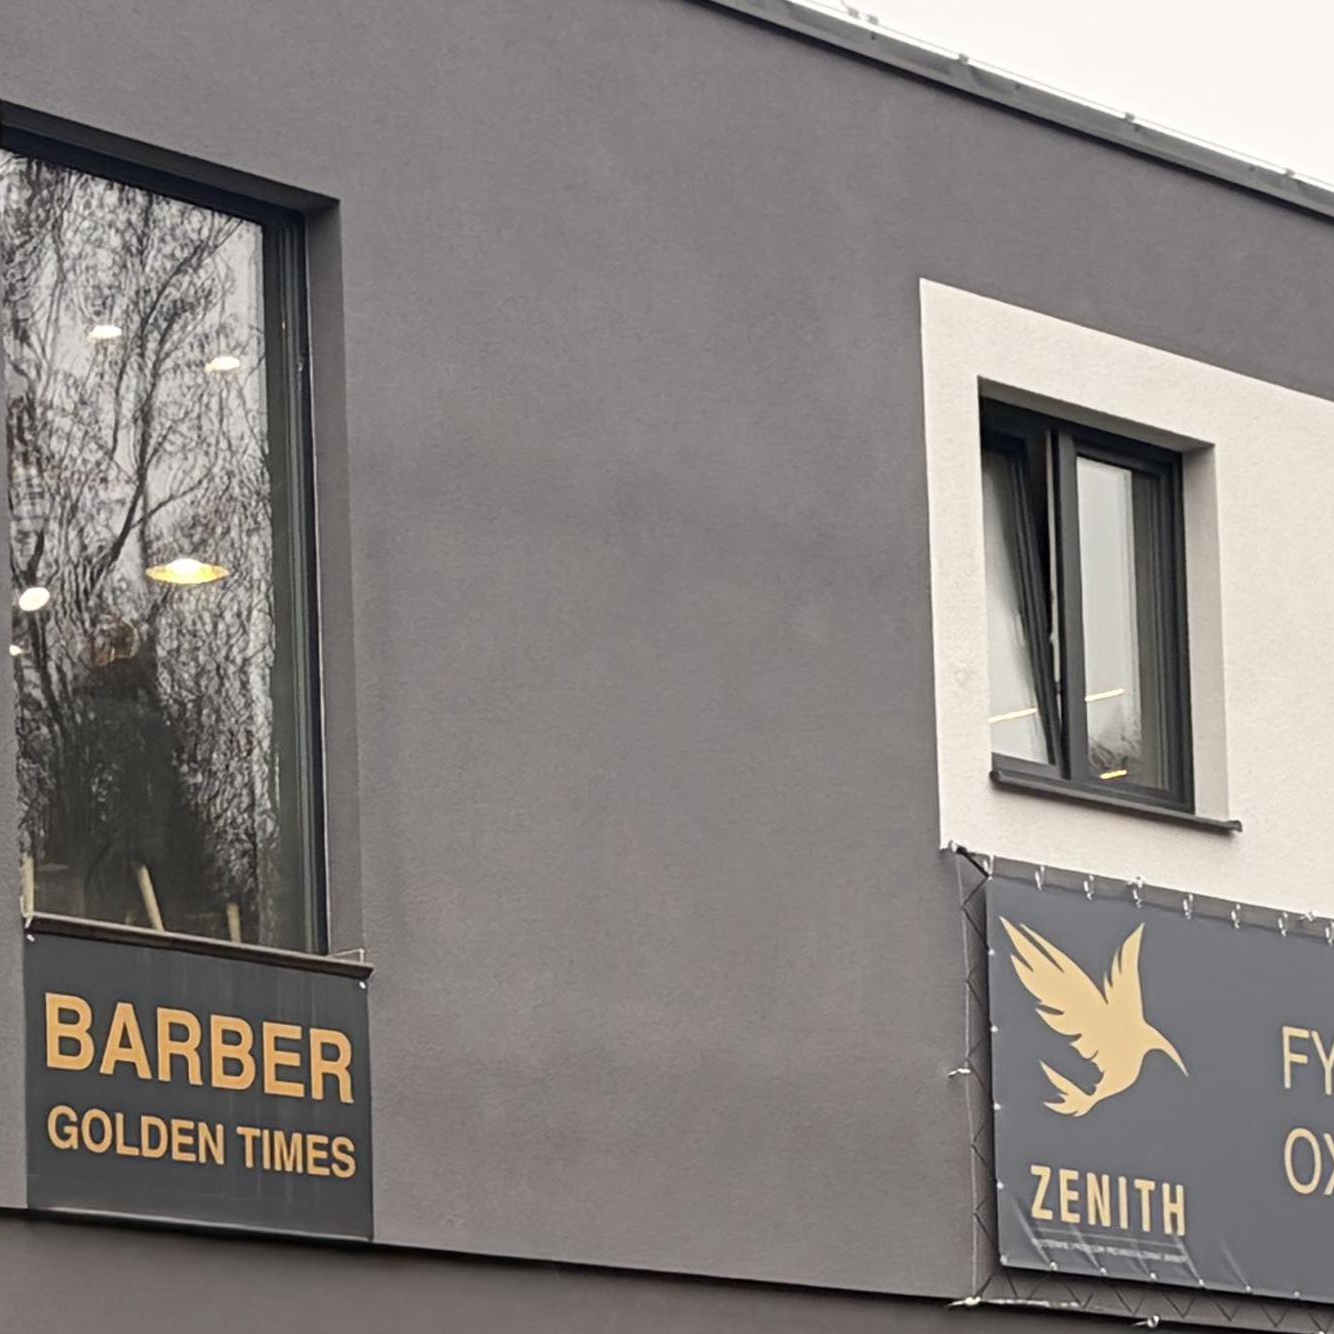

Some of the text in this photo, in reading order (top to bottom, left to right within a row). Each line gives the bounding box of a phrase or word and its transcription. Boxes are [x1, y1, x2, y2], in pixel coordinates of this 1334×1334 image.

[44, 991, 355, 1104] BARBER
[47, 1105, 356, 1178] GOLDEN TIMES
[1030, 1164, 1185, 1237] ZENITH
